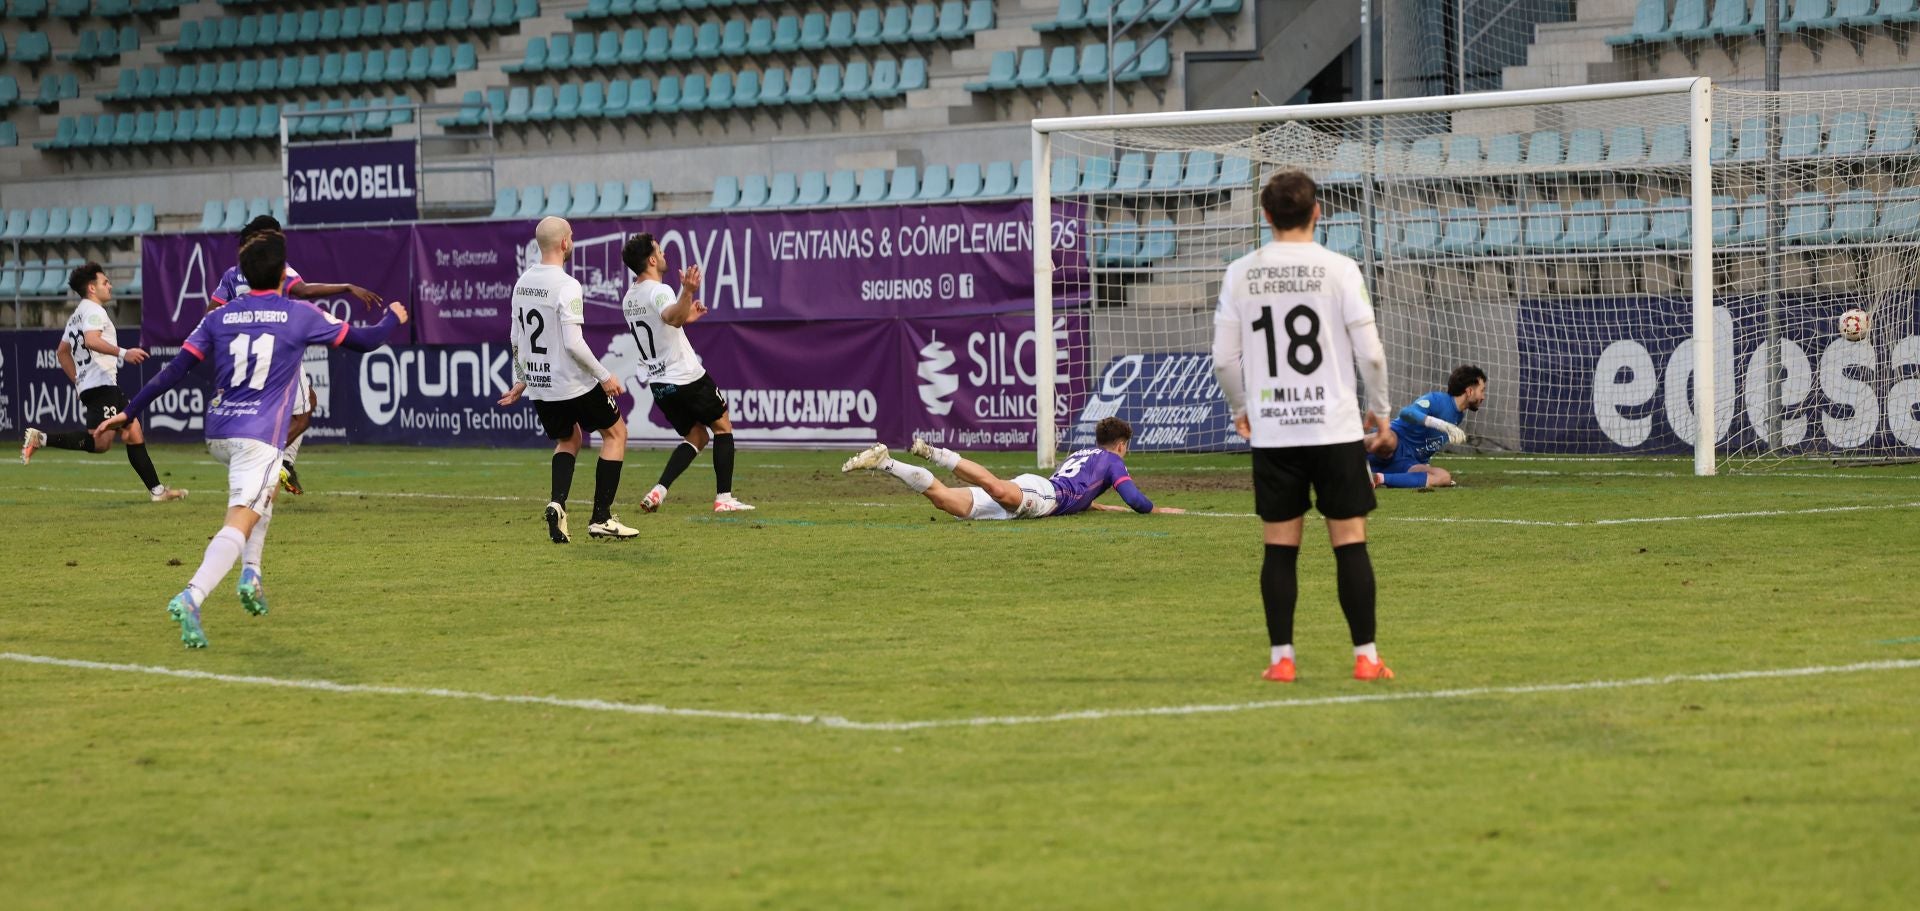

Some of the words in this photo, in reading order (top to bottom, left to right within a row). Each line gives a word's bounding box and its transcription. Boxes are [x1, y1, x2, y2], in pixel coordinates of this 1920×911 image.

[307, 167, 359, 201] TACO
[361, 164, 412, 199] BELL
[769, 228, 874, 260] VENTANAS
[880, 228, 892, 256] &
[628, 227, 763, 310] OYAL
[1247, 265, 1326, 281] COMBUSTIBLES
[862, 278, 932, 300] SIGUENOS
[1250, 282, 1261, 295] EL
[1264, 280, 1322, 294] REBOLLAR
[222, 311, 253, 325] GERARD
[255, 310, 288, 324] PUERTO
[518, 306, 547, 355] 12
[630, 321, 657, 361] 17
[1252, 304, 1323, 376] 18
[229, 332, 275, 391] 11
[361, 344, 510, 425] grunk
[1275, 386, 1325, 401] MILAR
[975, 388, 1068, 418] CLÍNICS
[1139, 402, 1212, 425] PROTECCIÓN
[1261, 406, 1289, 418] SIEGA
[1291, 405, 1325, 416] VERDE
[400, 407, 461, 435] Moving
[912, 427, 945, 444] dental
[958, 428, 992, 446] injerto
[993, 429, 1029, 447] capilar
[1136, 426, 1189, 445] LABORAL
